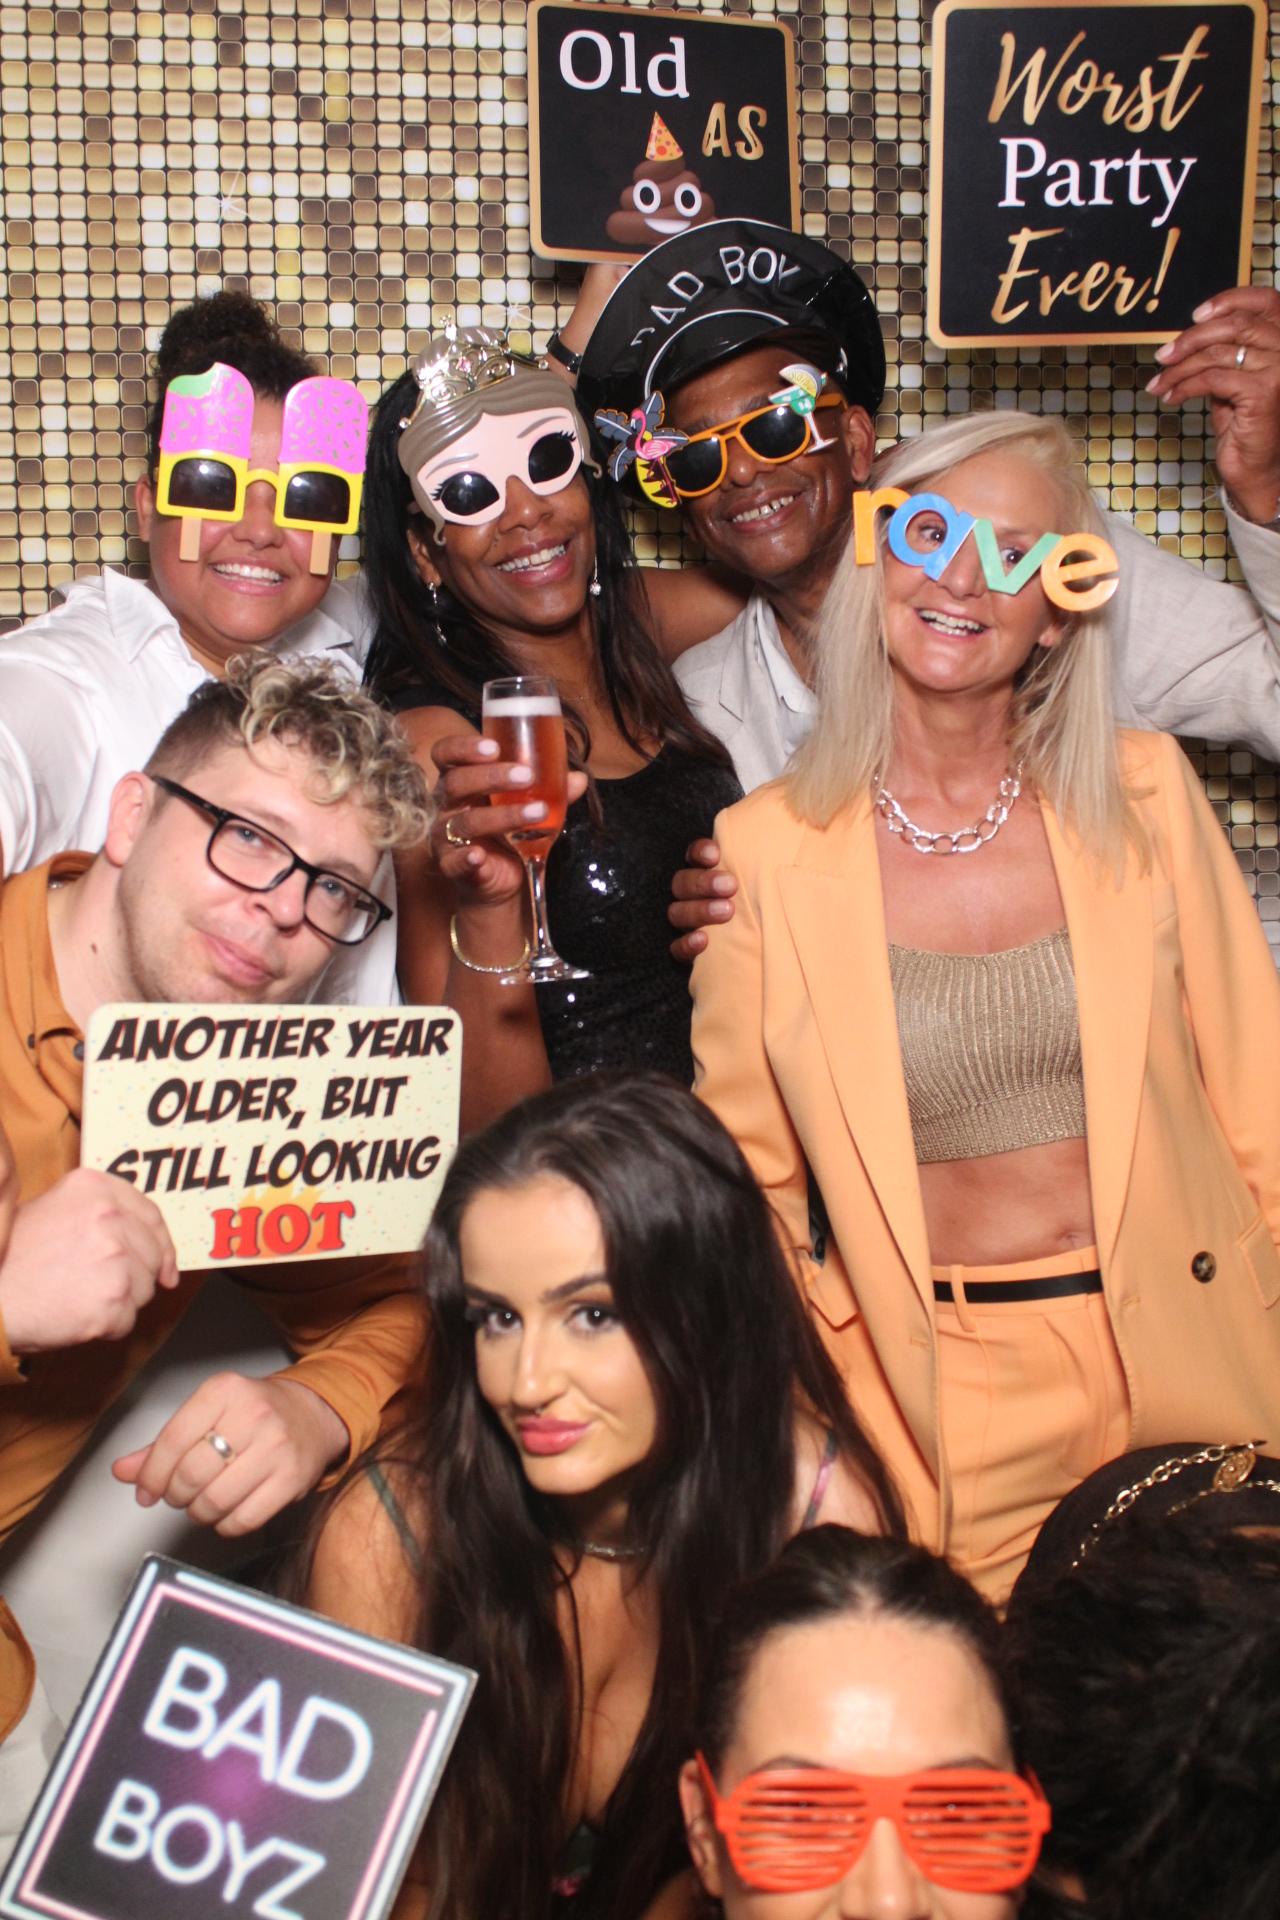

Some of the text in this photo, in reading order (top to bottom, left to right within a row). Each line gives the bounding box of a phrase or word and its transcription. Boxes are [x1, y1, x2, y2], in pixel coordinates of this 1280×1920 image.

[559, 29, 690, 98] Old
[987, 24, 1210, 133] Worst
[702, 102, 768, 161] AS
[997, 137, 1198, 227] Party
[990, 227, 1181, 324] Ever!
[852, 487, 1120, 612] rave
[96, 1016, 454, 1063] ANOTHER YEAR
[147, 1076, 409, 1130] OLDER, BUT
[106, 1136, 442, 1194] STILL LOOKING
[208, 1201, 356, 1260] HOT
[142, 1646, 373, 1801] BAD
[93, 1778, 327, 1920] BOYZ
